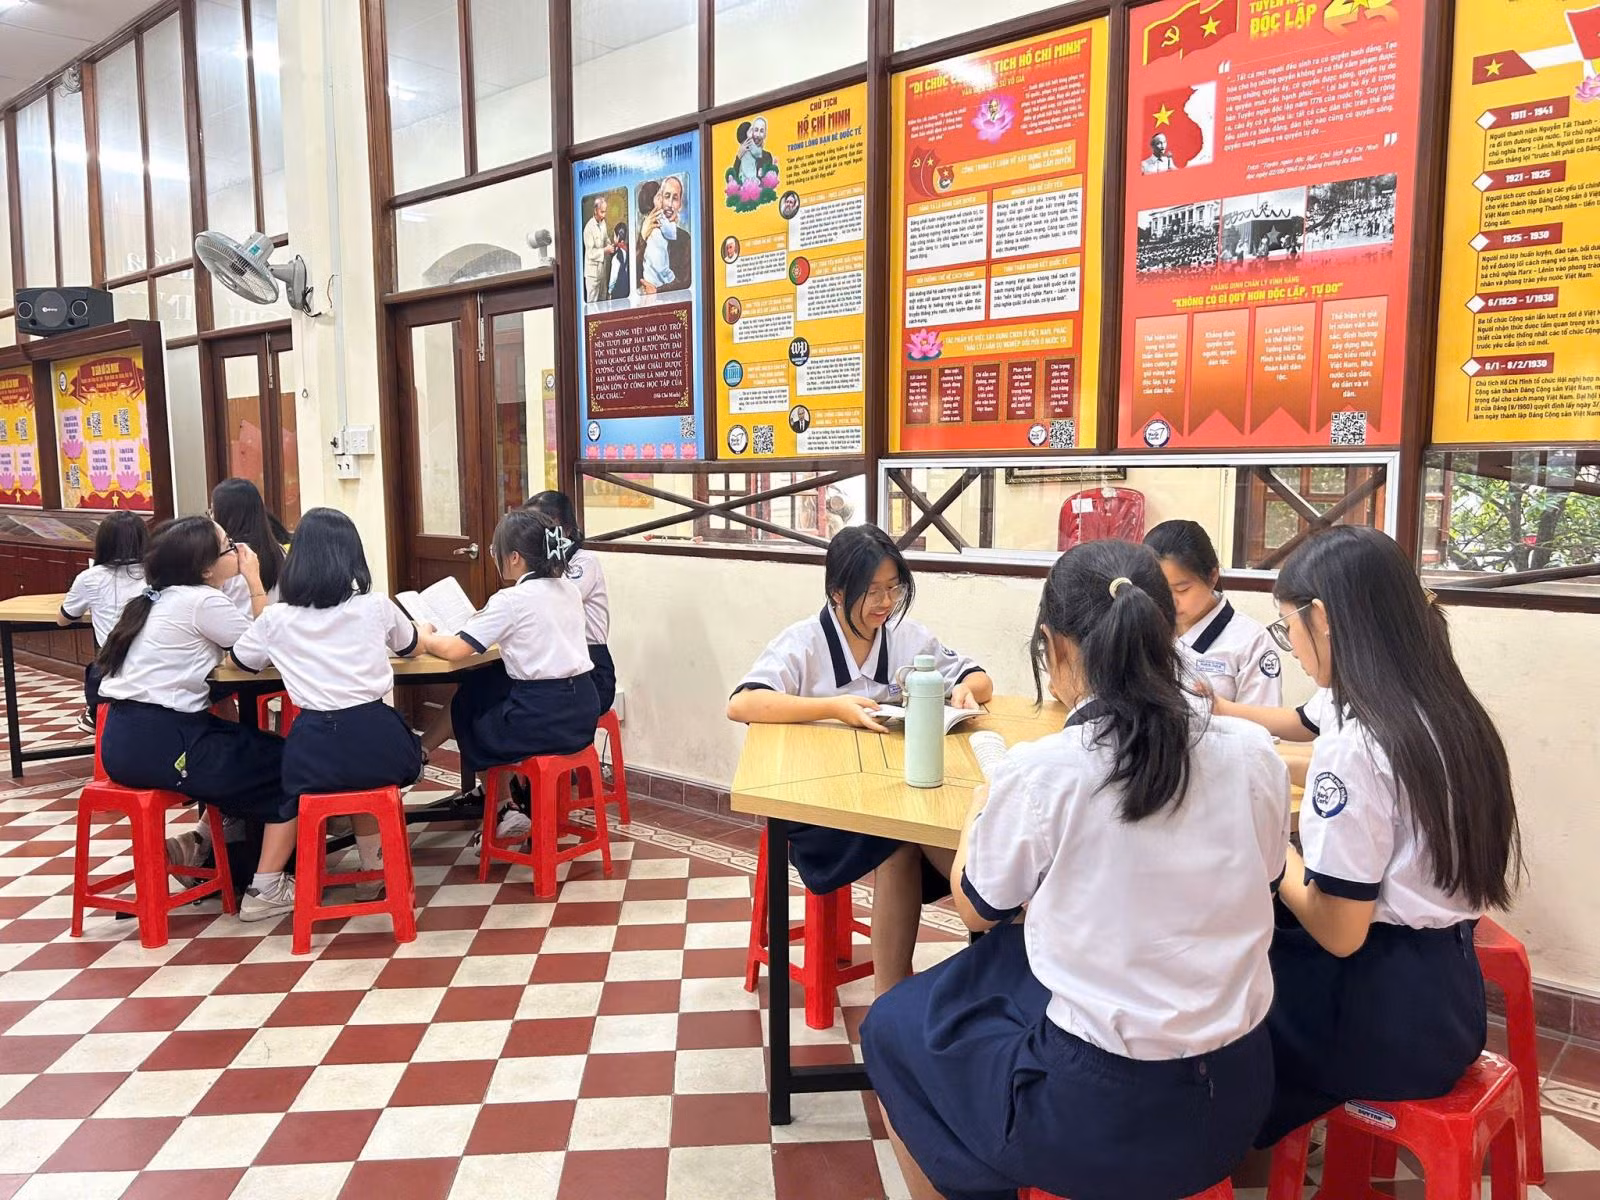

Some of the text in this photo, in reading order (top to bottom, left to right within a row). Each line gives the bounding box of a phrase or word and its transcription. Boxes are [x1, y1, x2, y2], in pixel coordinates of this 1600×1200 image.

[1249, 2, 1318, 34] ĐỘC LẬP
[925, 74, 949, 91] CHÚC
[993, 57, 1017, 74] TỊCH
[1018, 47, 1033, 68] HỒ
[1034, 44, 1052, 63] CHÍ
[810, 97, 838, 111] CHỦ TỊCH
[797, 108, 850, 131] HỒ CHÍ MINH
[673, 142, 692, 159] MINH
[1267, 287, 1285, 300] ĐỘC
[1507, 359, 1548, 369] 8/2/1930
